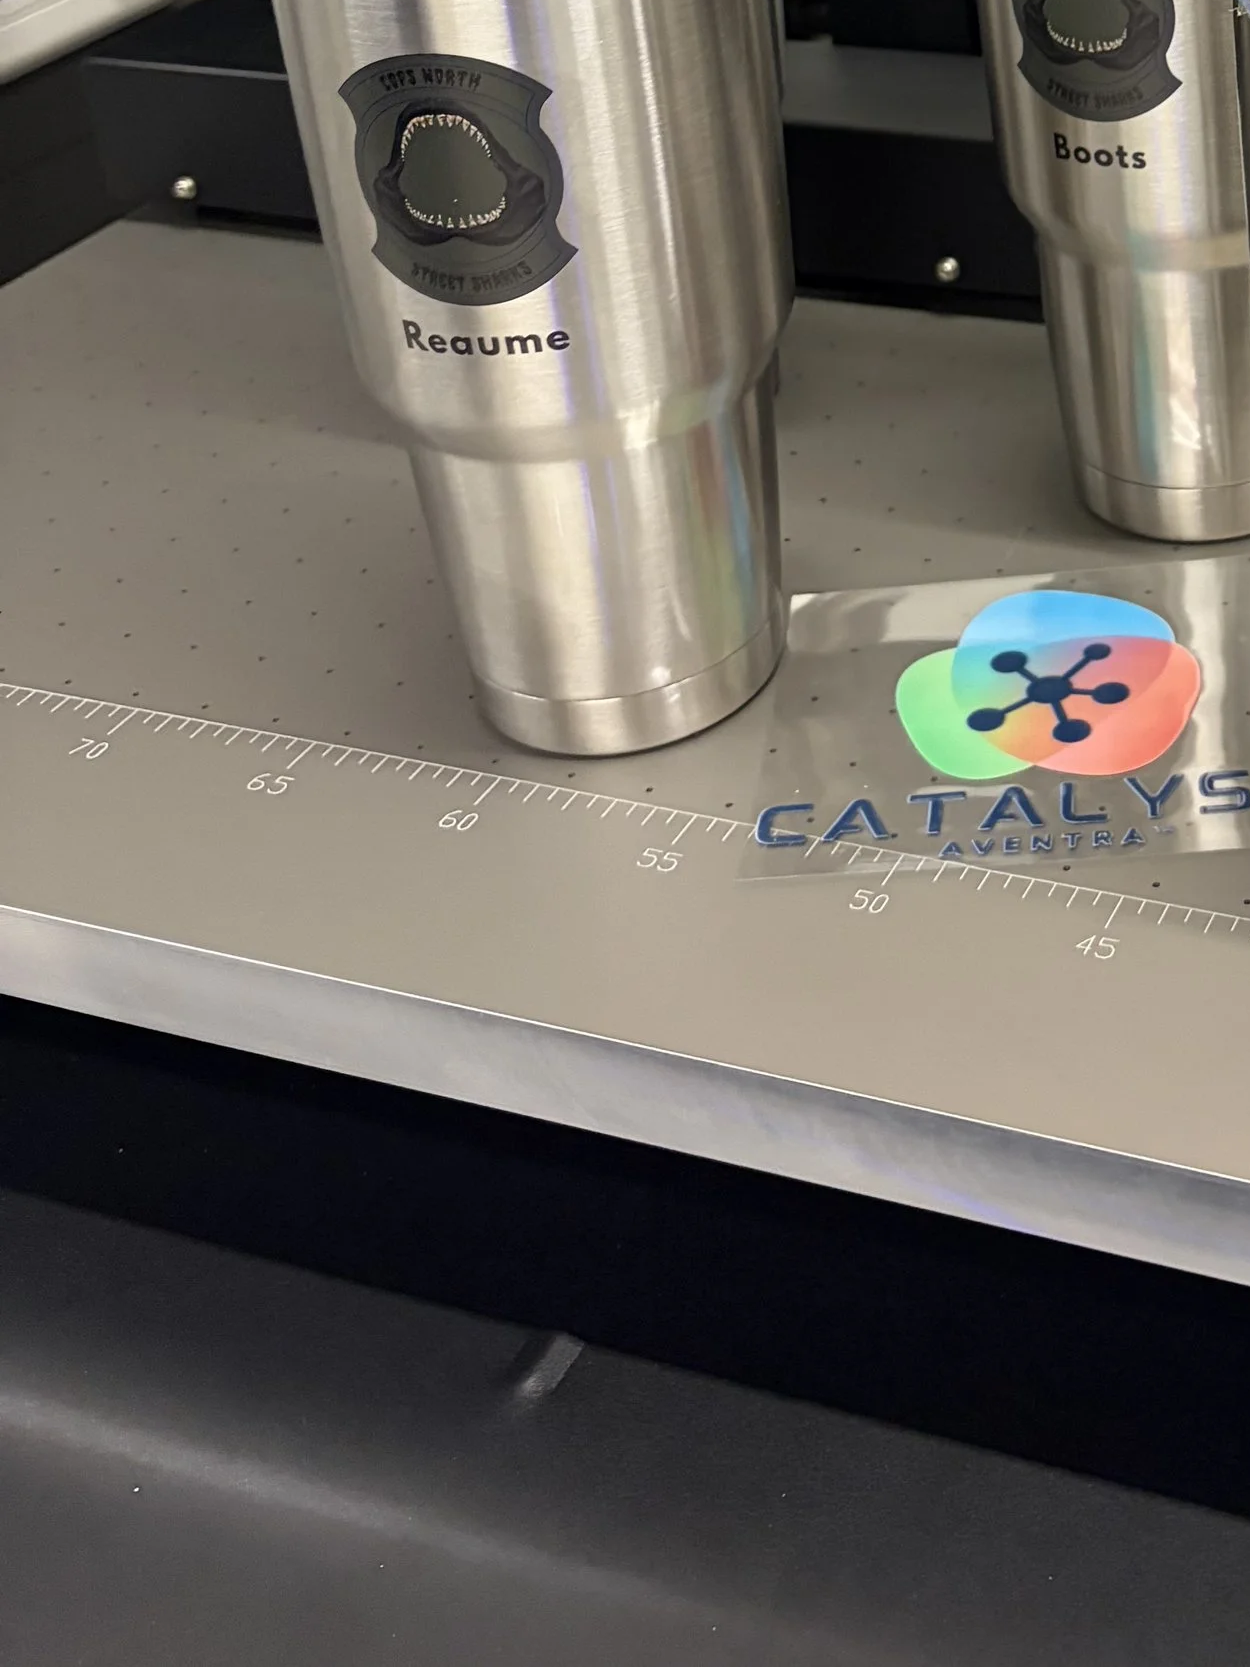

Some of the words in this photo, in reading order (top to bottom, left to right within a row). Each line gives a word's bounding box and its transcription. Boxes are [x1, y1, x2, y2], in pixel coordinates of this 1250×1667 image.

[421, 68, 482, 89] NORTH
[1053, 132, 1147, 169] Boots
[402, 319, 571, 356] Reaume
[68, 738, 109, 760] 70
[246, 772, 294, 795] 65
[438, 810, 479, 831] 60
[938, 827, 1146, 858] AVENTRA
[636, 847, 683, 872] 55
[849, 889, 889, 914] 50
[1075, 934, 1120, 960] 45
